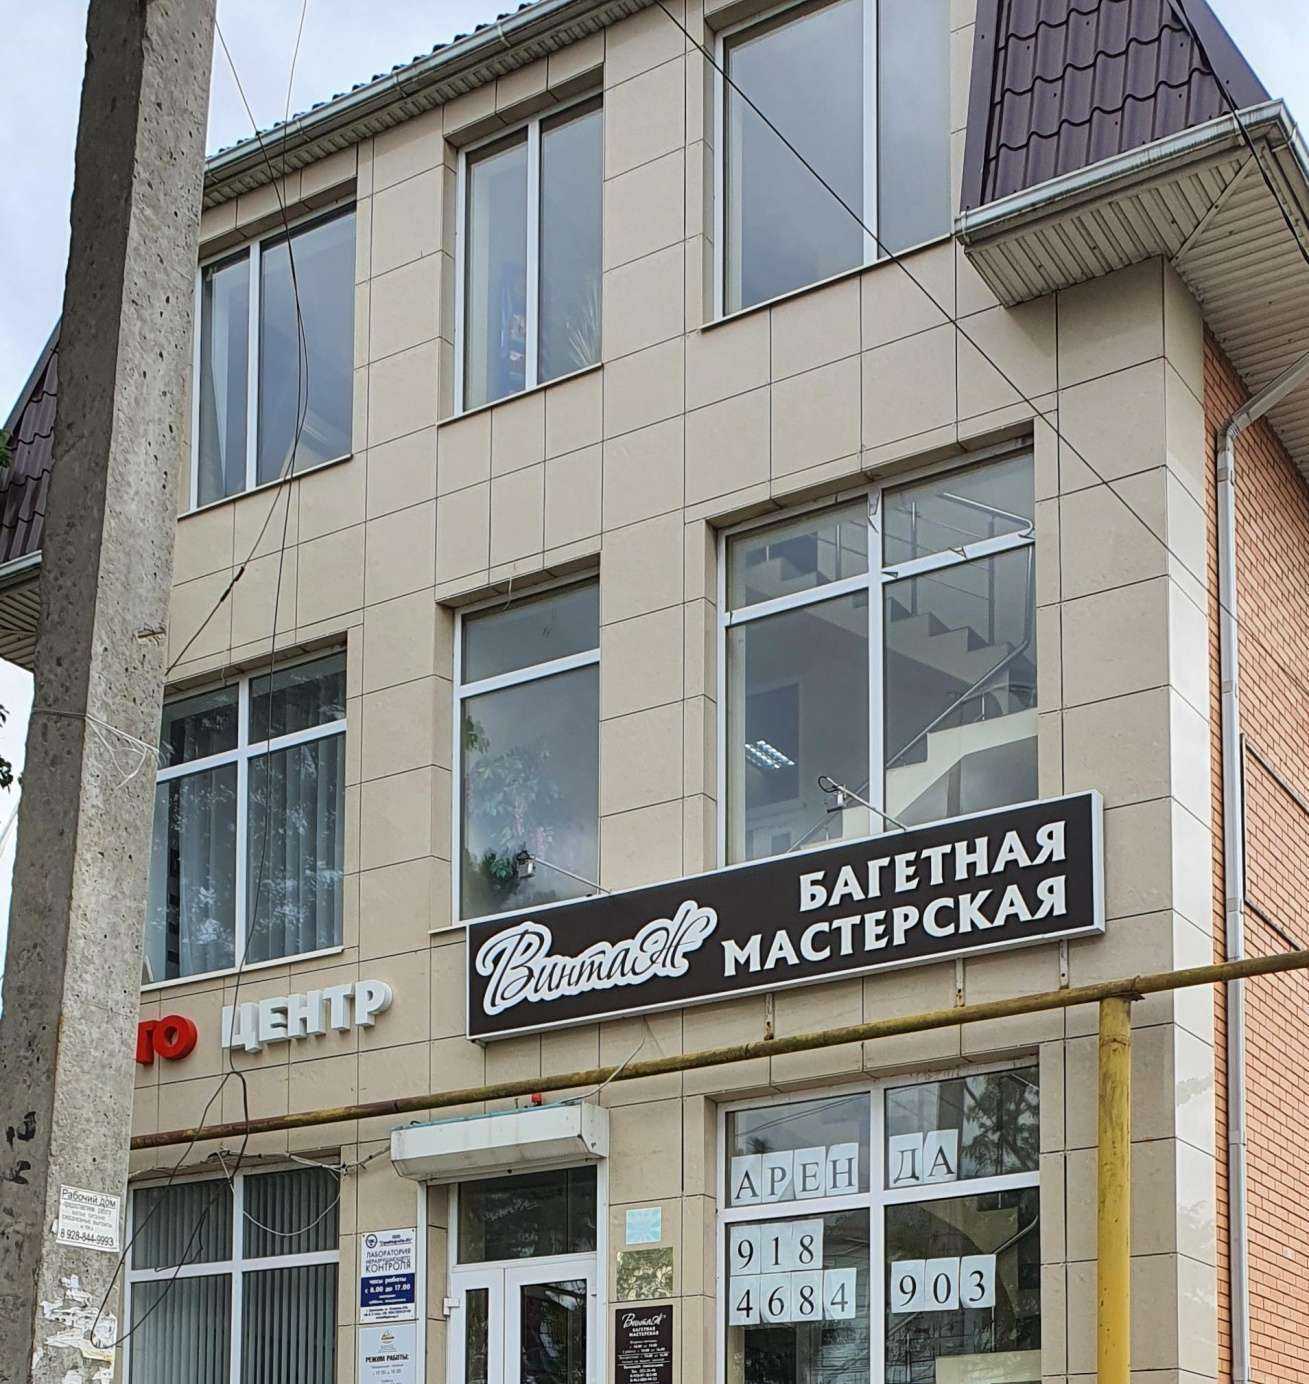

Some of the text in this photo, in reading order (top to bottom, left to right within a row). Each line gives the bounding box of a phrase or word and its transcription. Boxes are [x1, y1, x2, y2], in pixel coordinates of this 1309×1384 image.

[799, 820, 1066, 912] БАГЕТНАЯ
[722, 875, 1067, 977] МАСТЕРСКАЯ
[222, 980, 393, 1054] ЦЕНТР
[63, 1189, 116, 1208] Рабочий дом
[366, 1248, 410, 1258] ЛАБОРАТОРИЯ
[737, 1234, 814, 1269] 918
[366, 1261, 411, 1273] КОНТРОЛЯ
[385, 1276, 406, 1285] работы
[736, 1270, 985, 1318] 4684 903
[365, 1355, 385, 1363] РЕЖИМ
